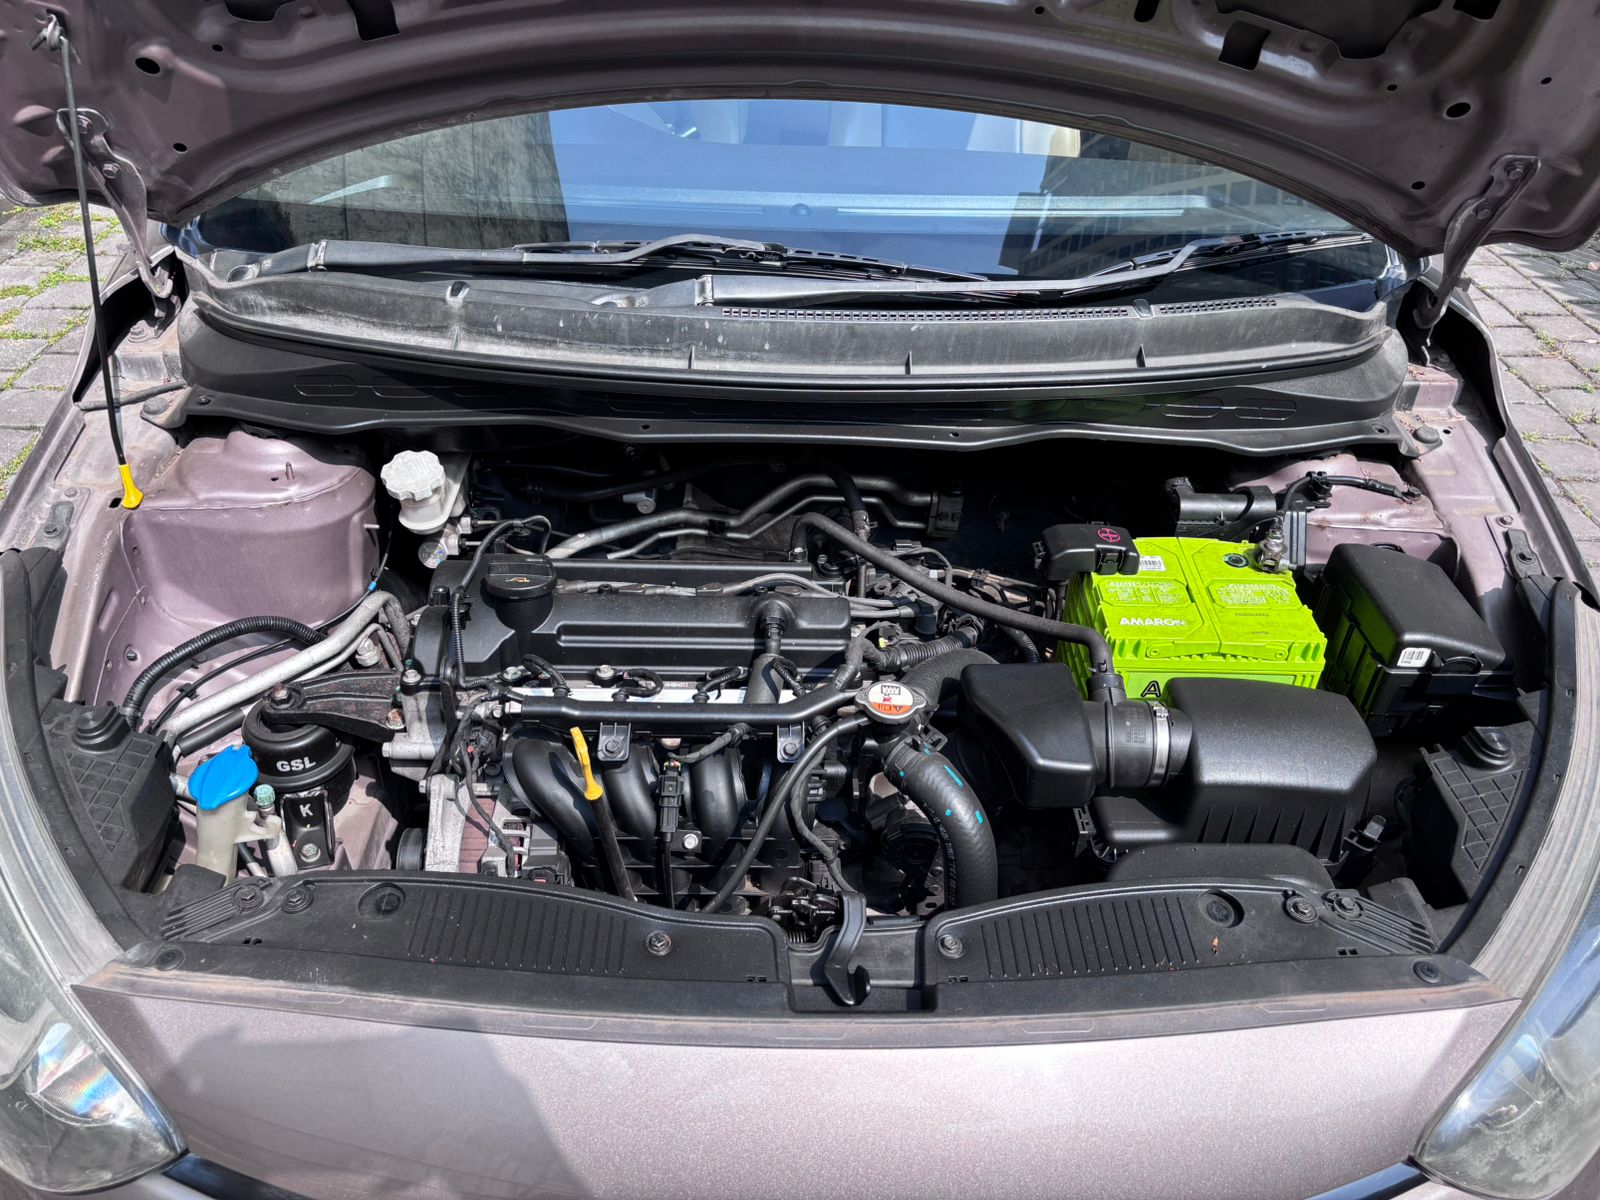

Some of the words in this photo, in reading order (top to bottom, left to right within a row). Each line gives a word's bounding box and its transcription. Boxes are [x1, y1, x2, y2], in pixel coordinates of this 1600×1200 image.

[1119, 617, 1185, 626] AMARON
[1141, 681, 1161, 697] A
[276, 756, 316, 772] GSL
[299, 803, 313, 817] K
